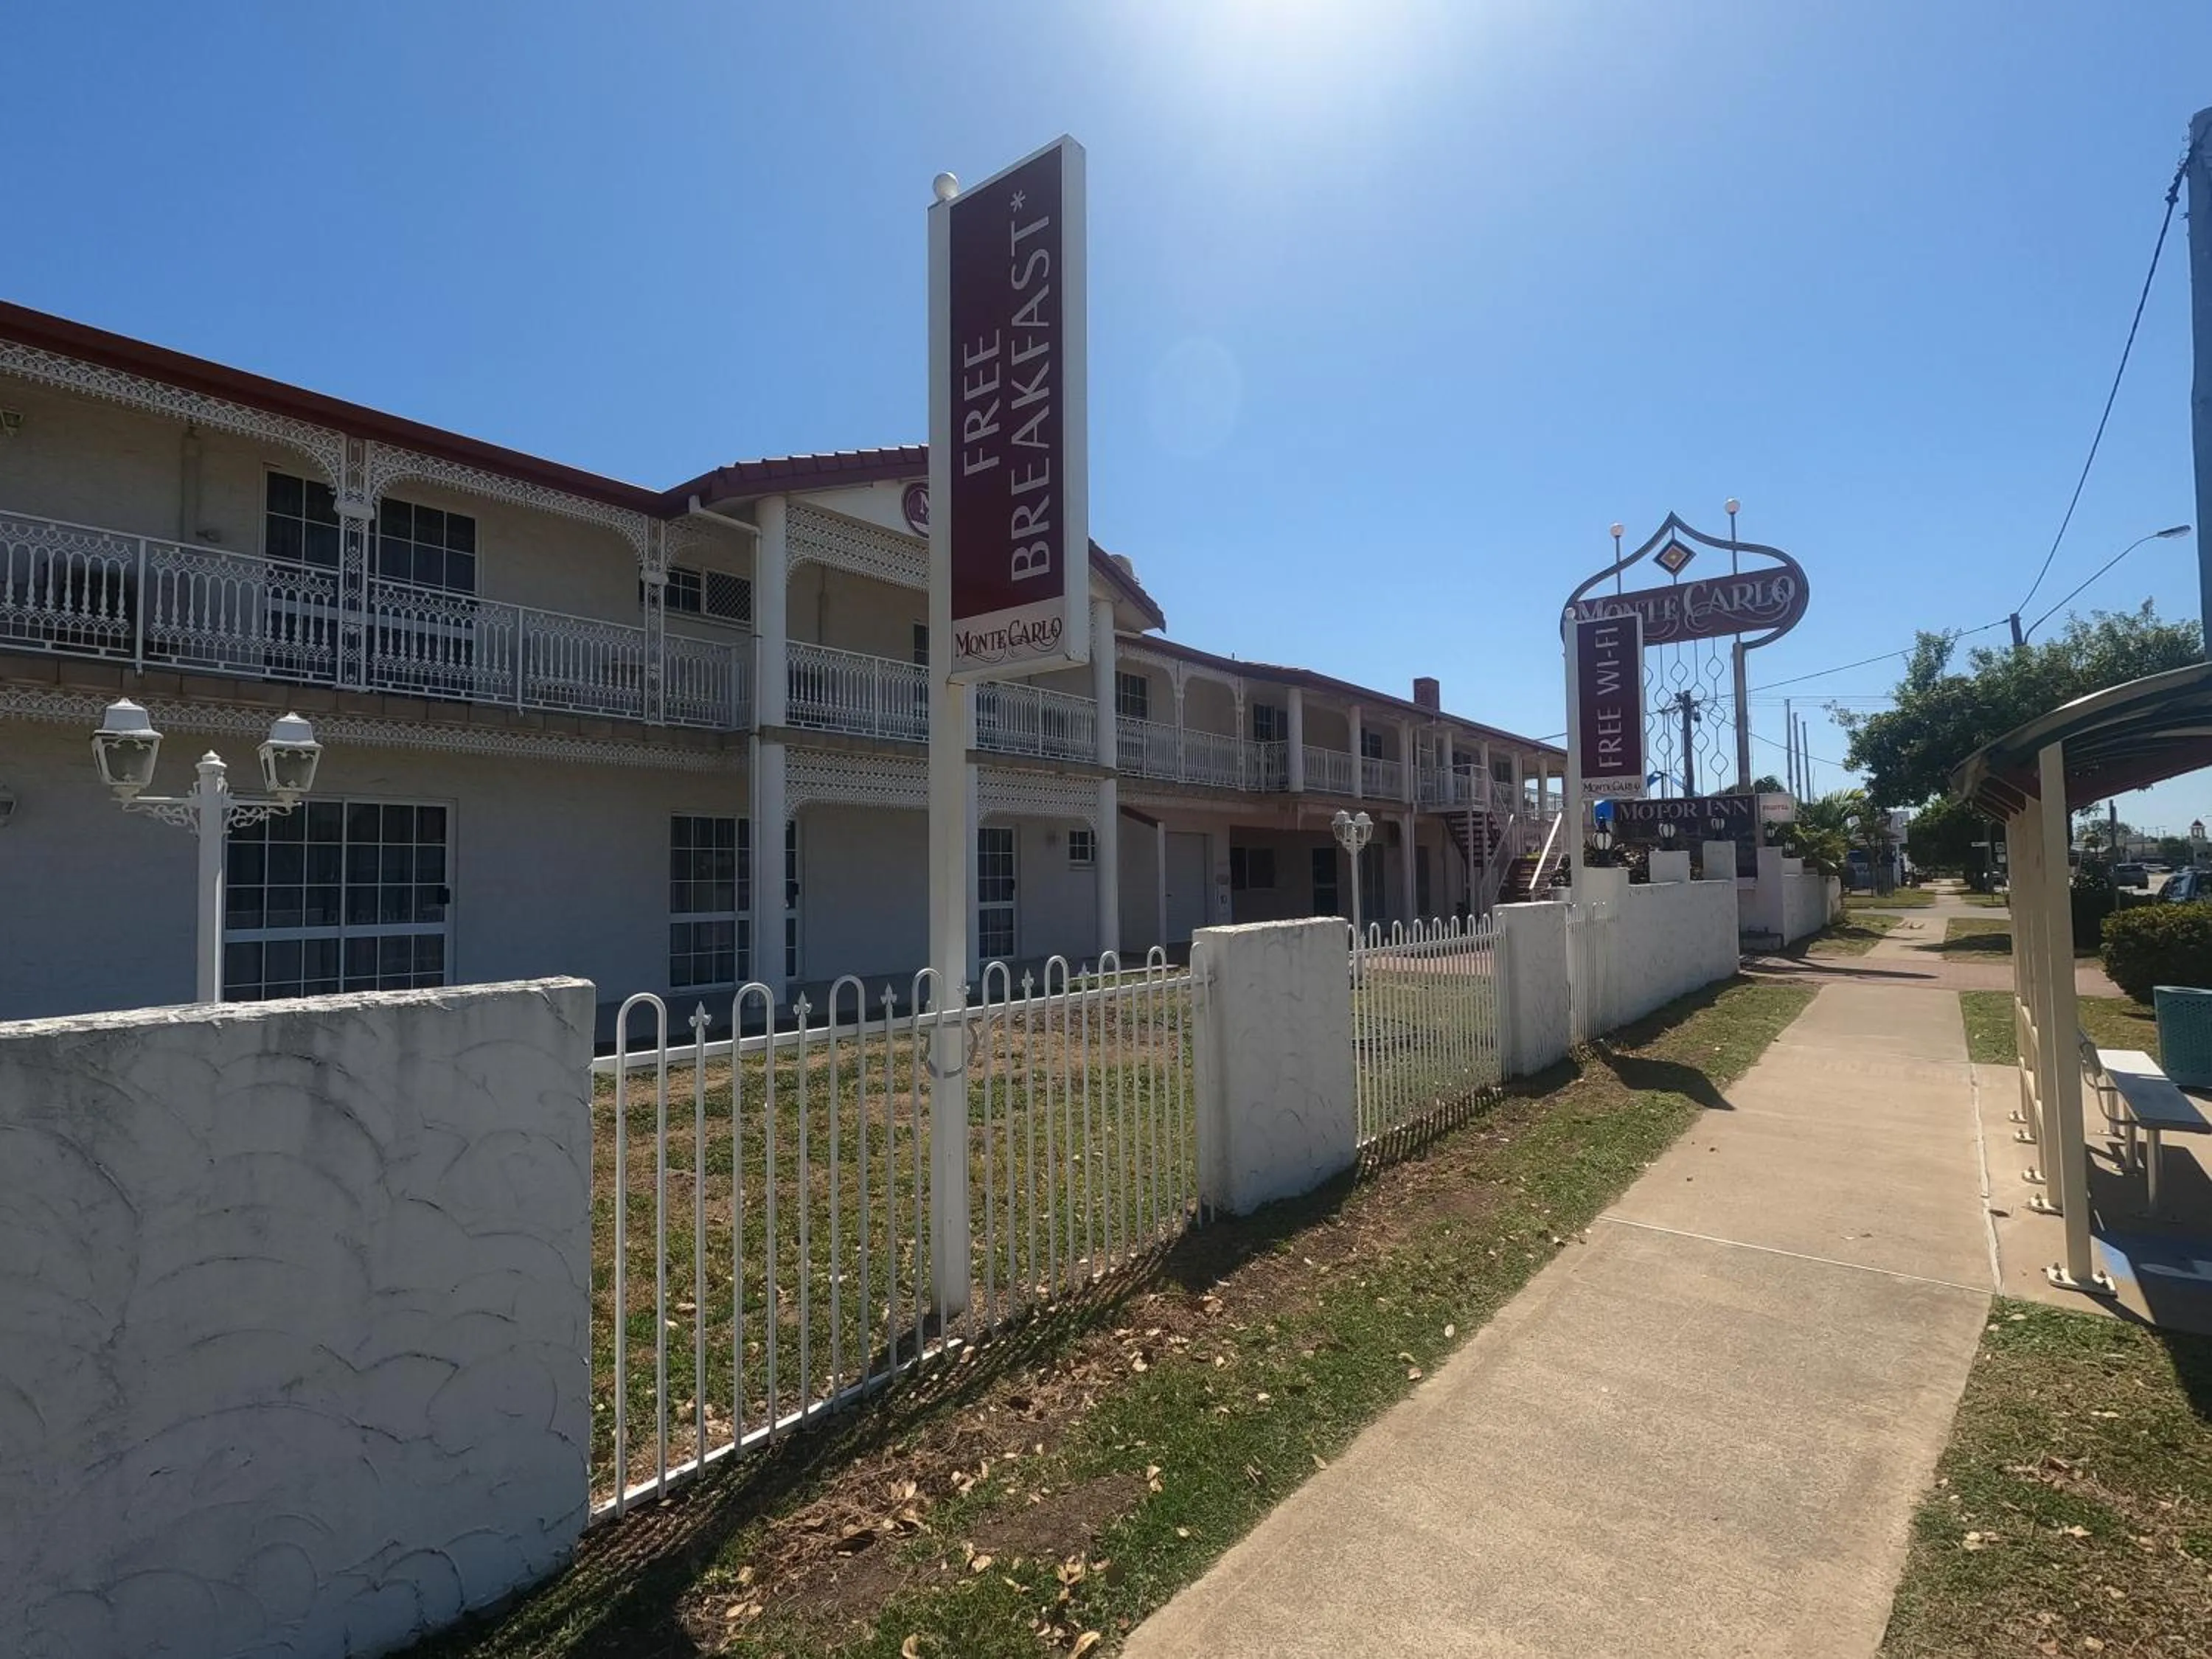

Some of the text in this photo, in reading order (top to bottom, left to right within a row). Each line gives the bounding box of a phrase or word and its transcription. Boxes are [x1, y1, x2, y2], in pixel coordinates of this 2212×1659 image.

[964, 329, 1001, 476] FREE
[1683, 575, 1796, 624] CARLO
[956, 617, 1062, 663] MONTE CARLO
[1596, 627, 1623, 768] FREE WI-FI
[1619, 799, 1748, 821] MOTOR INN
